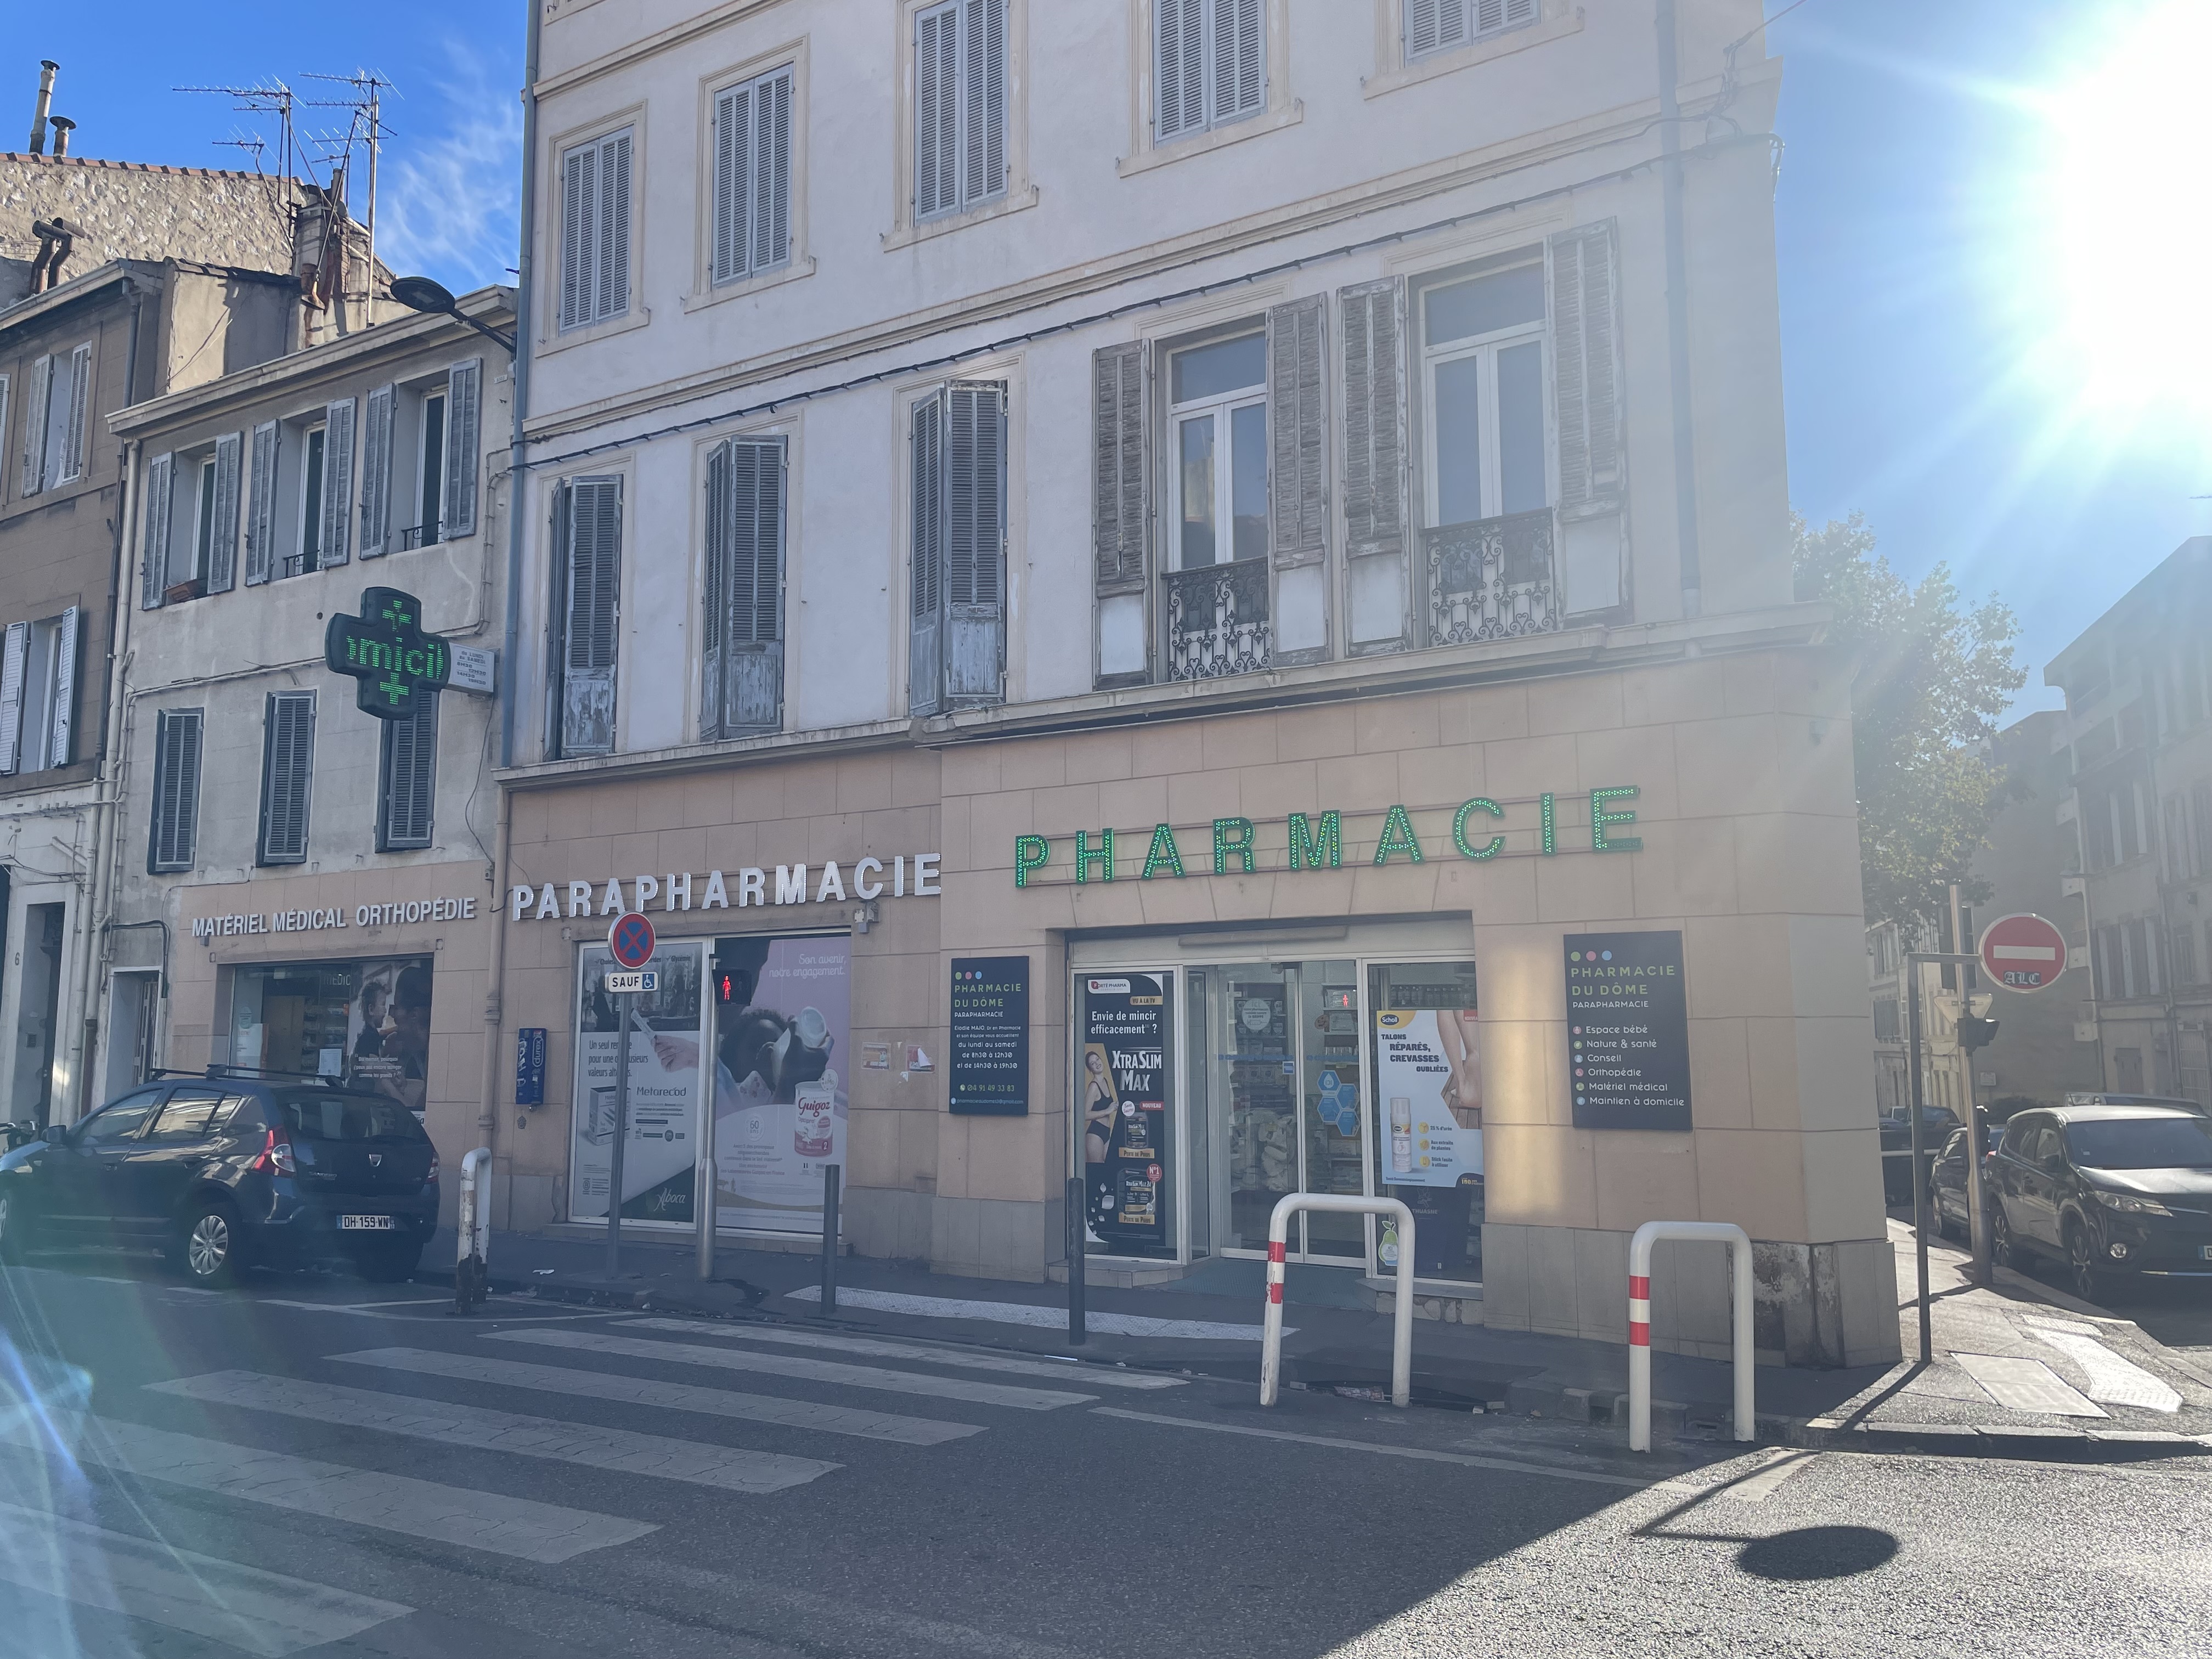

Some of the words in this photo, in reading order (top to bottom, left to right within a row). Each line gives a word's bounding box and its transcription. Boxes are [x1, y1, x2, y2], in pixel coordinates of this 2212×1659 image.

[1015, 785, 1643, 888] PHARMACIE
[512, 853, 941, 921] PARAPHARMACIE
[192, 913, 268, 936] MATÉRIEL
[273, 908, 347, 932] MÉDICAL
[356, 897, 476, 926] ORTHOPÉDIE
[15, 952, 20, 966] 6
[799, 953, 816, 964] Son
[819, 953, 847, 965] avenir,
[769, 967, 791, 978] notre
[1571, 966, 1675, 978] PHARMACIE
[612, 976, 639, 987] SAUF
[955, 983, 1021, 993] PHARMACIE
[1572, 985, 1593, 996] DU
[1600, 982, 1648, 995] DÔME
[955, 999, 968, 1007] DU
[973, 996, 1003, 1007] DÔME
[1092, 1011, 1114, 1020] Envie
[1116, 1011, 1126, 1020] de
[1129, 1010, 1156, 1020] mincir
[1152, 1024, 1157, 1034] ?
[1586, 1026, 1620, 1035] Espace
[1623, 1024, 1648, 1034] bébé
[589, 1040, 597, 1049] Un
[599, 1040, 610, 1049] seul
[1390, 1042, 1431, 1052] RÉPARÉS,
[1621, 1039, 1628, 1048] &
[1631, 1039, 1657, 1048] santé
[589, 1056, 601, 1065] pour
[588, 1067, 608, 1076] valeurs
[1588, 1068, 1641, 1077] Orthopédie
[636, 1086, 686, 1096] Metarecod
[1589, 1082, 1626, 1091] Matériel
[1629, 1082, 1668, 1091] médical
[1590, 1097, 1630, 1105] Maintien
[1633, 1096, 1640, 1105] à
[1643, 1097, 1684, 1106] domicile
[798, 1097, 830, 1117] Guigoz
[750, 1120, 759, 1129] 60
[823, 1142, 827, 1150] 2
[653, 1187, 686, 1211] Aboca
